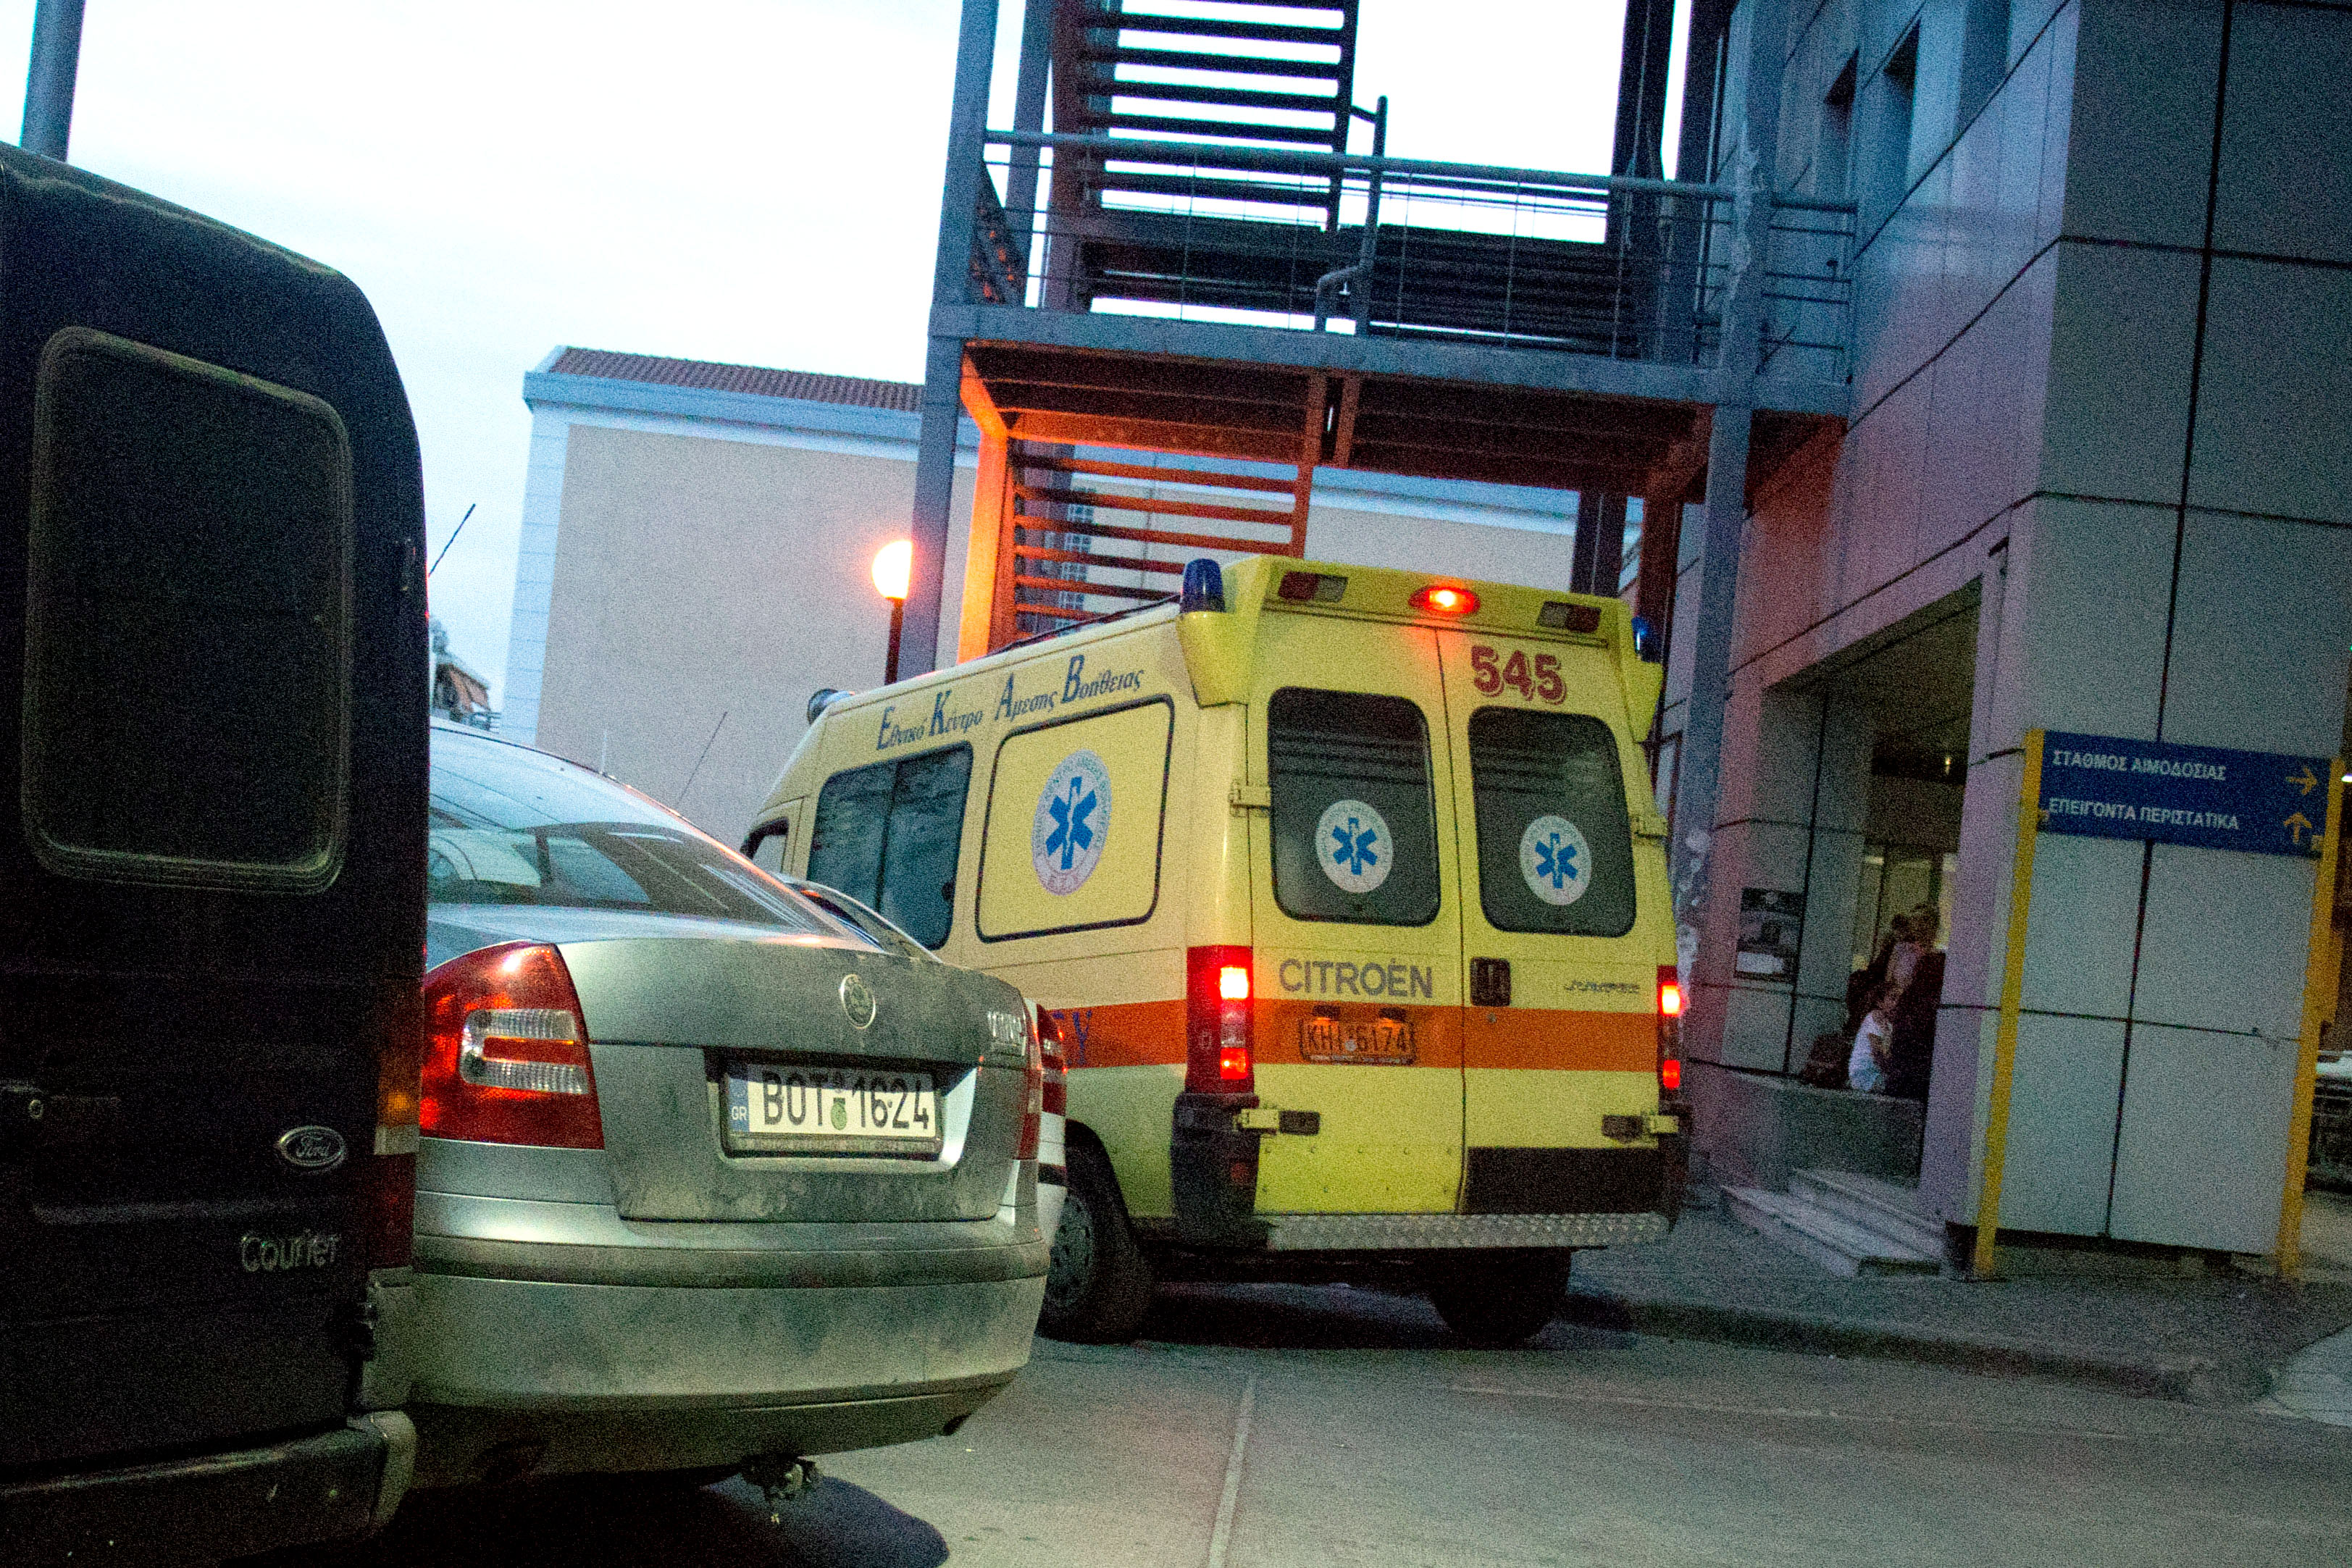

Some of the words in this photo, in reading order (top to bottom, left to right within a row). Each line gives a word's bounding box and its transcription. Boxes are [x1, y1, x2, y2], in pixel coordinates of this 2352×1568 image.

[1470, 645, 1567, 705] 545
[2052, 749, 2127, 772] ΣΤΑΘΜΟΣ
[2131, 757, 2227, 781] ΑΙΜΟΔΟΣΙΑΣ
[2048, 797, 2136, 821] ΕΠΕΙΓΟΝΤΑ
[2140, 806, 2240, 830] ΠΕΡΙΣΤΑΤΙΚΑ
[731, 1105, 747, 1121] GR
[295, 1135, 332, 1157] Ford
[241, 1230, 339, 1272] Courier
